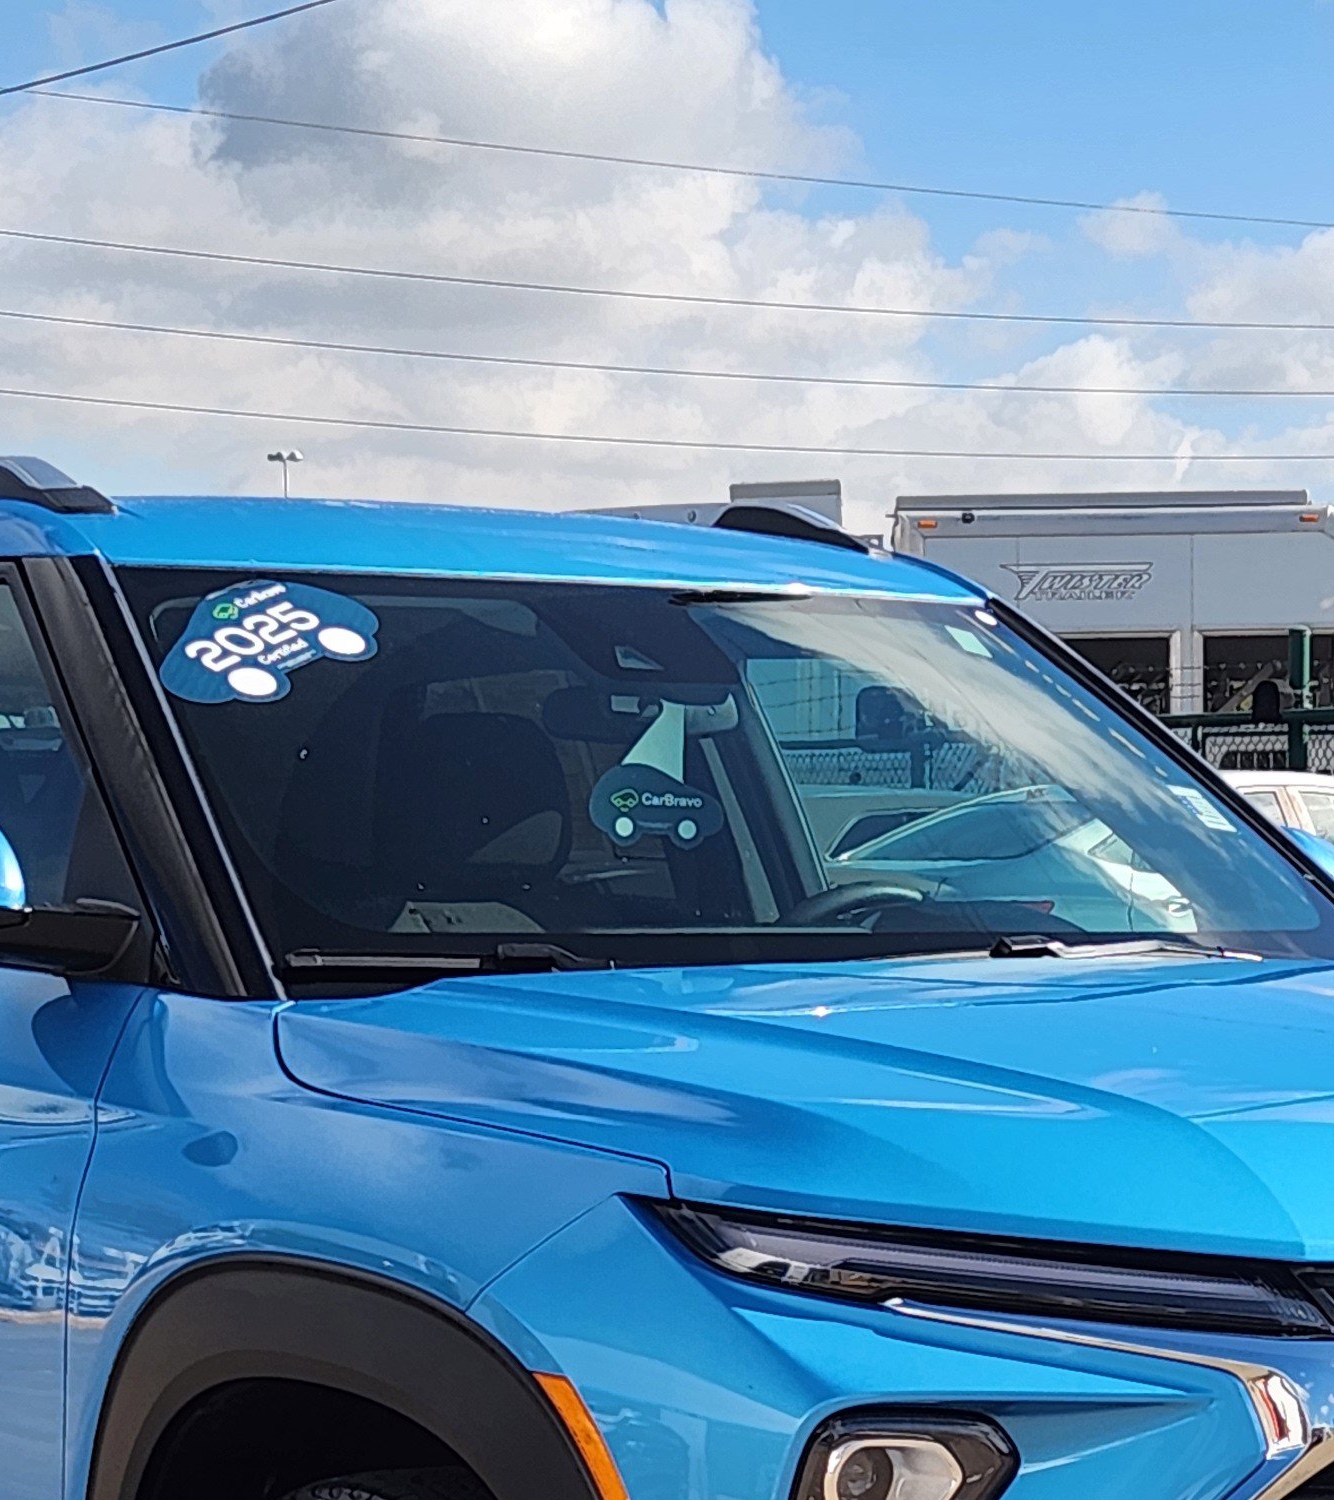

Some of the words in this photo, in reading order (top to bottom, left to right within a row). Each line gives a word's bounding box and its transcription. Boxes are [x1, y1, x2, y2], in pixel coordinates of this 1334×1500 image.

[1000, 562, 1153, 600] TWISTER
[185, 601, 320, 673] 2025
[641, 792, 703, 808] CarBravo
